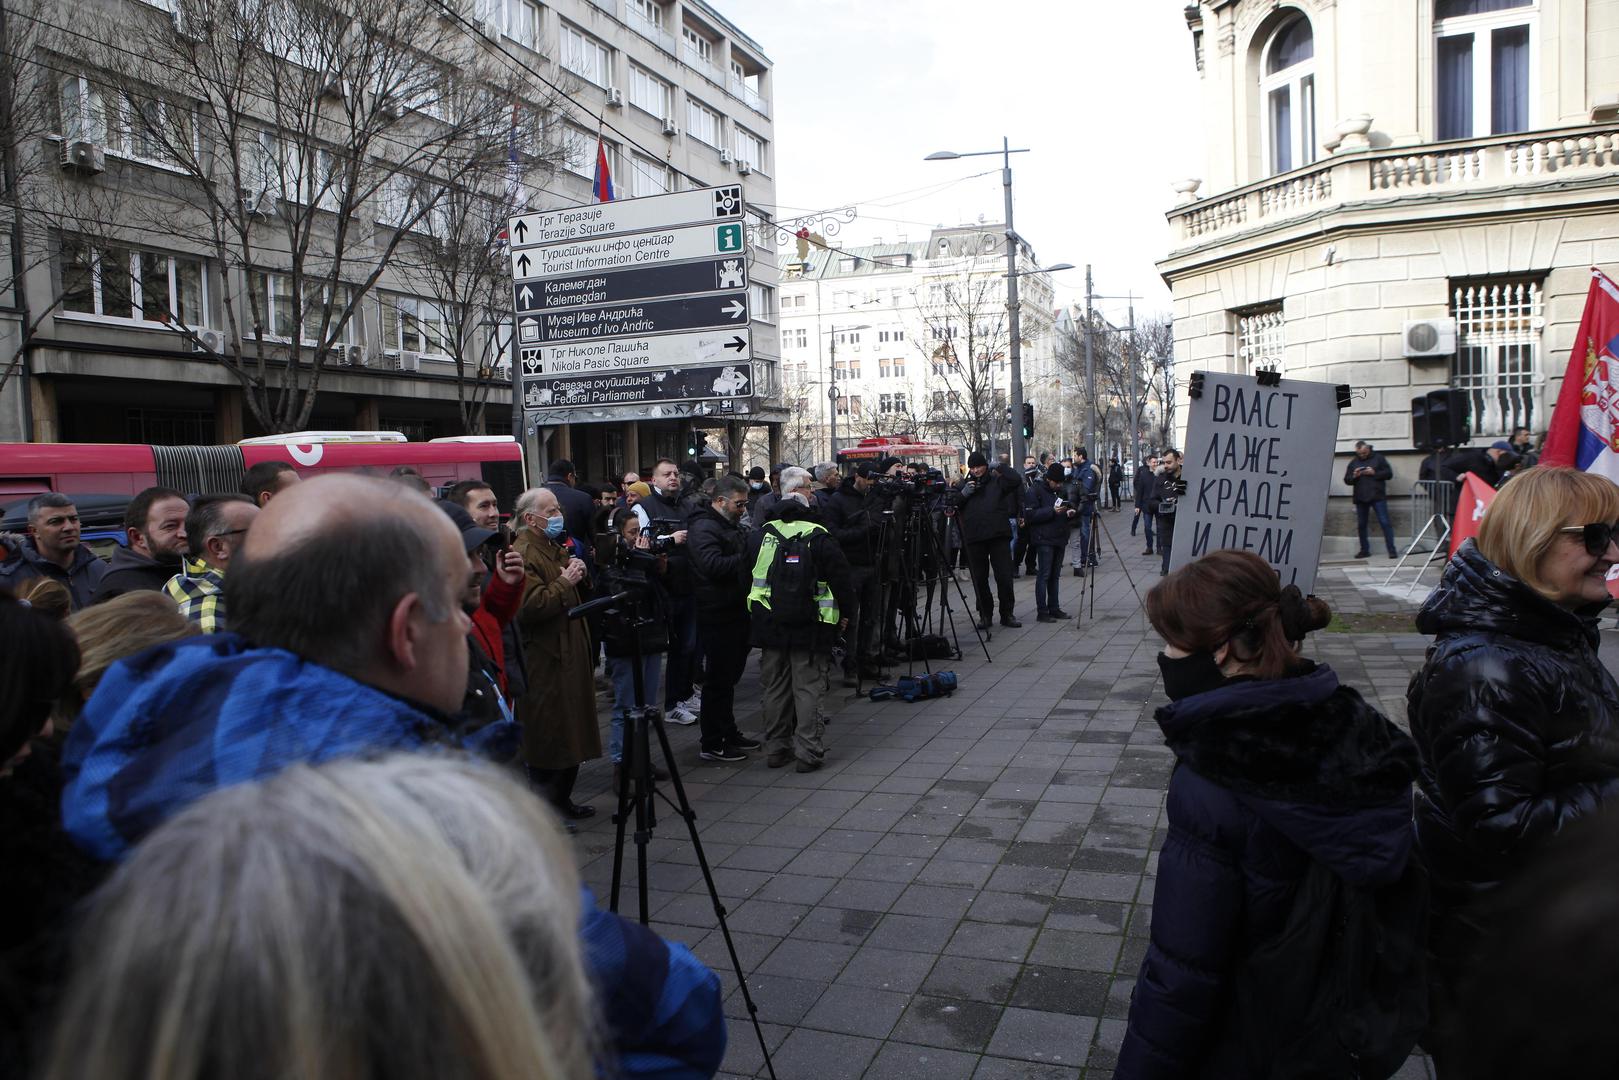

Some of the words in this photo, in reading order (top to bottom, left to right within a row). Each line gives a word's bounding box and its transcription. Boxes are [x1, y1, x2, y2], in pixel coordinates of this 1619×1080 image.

[539, 215, 555, 228] Трг
[558, 209, 602, 225] Теразије
[539, 226, 578, 240] Terazije
[580, 221, 615, 236] Square
[541, 245, 601, 261] Туристички
[603, 240, 630, 253] инфо
[633, 234, 674, 249] центар
[542, 261, 574, 273] Tourist
[576, 254, 632, 269] Information
[635, 249, 670, 261] Centre
[545, 276, 606, 293] Калемегдан
[546, 291, 606, 306] Kalemegdan
[547, 313, 575, 327] Музеј
[577, 312, 597, 323] Иве
[599, 307, 643, 321] Андрића
[548, 326, 590, 339] Museum
[592, 324, 602, 335] of
[604, 322, 619, 333] Ivo
[621, 319, 654, 332] Andric
[551, 348, 567, 359] Трг
[568, 345, 605, 357] Николе
[608, 341, 648, 355] Пашића
[552, 359, 581, 372] Nikola
[584, 358, 612, 369] Pasic
[614, 355, 649, 368] Square
[553, 378, 592, 392] Савезна
[554, 391, 590, 404] Federal
[592, 390, 645, 402] Parliament
[1213, 384, 1298, 429] ВЛАСТ
[1204, 433, 1288, 477] ЛАЖЕ,
[1197, 478, 1292, 520] КРАДЕ
